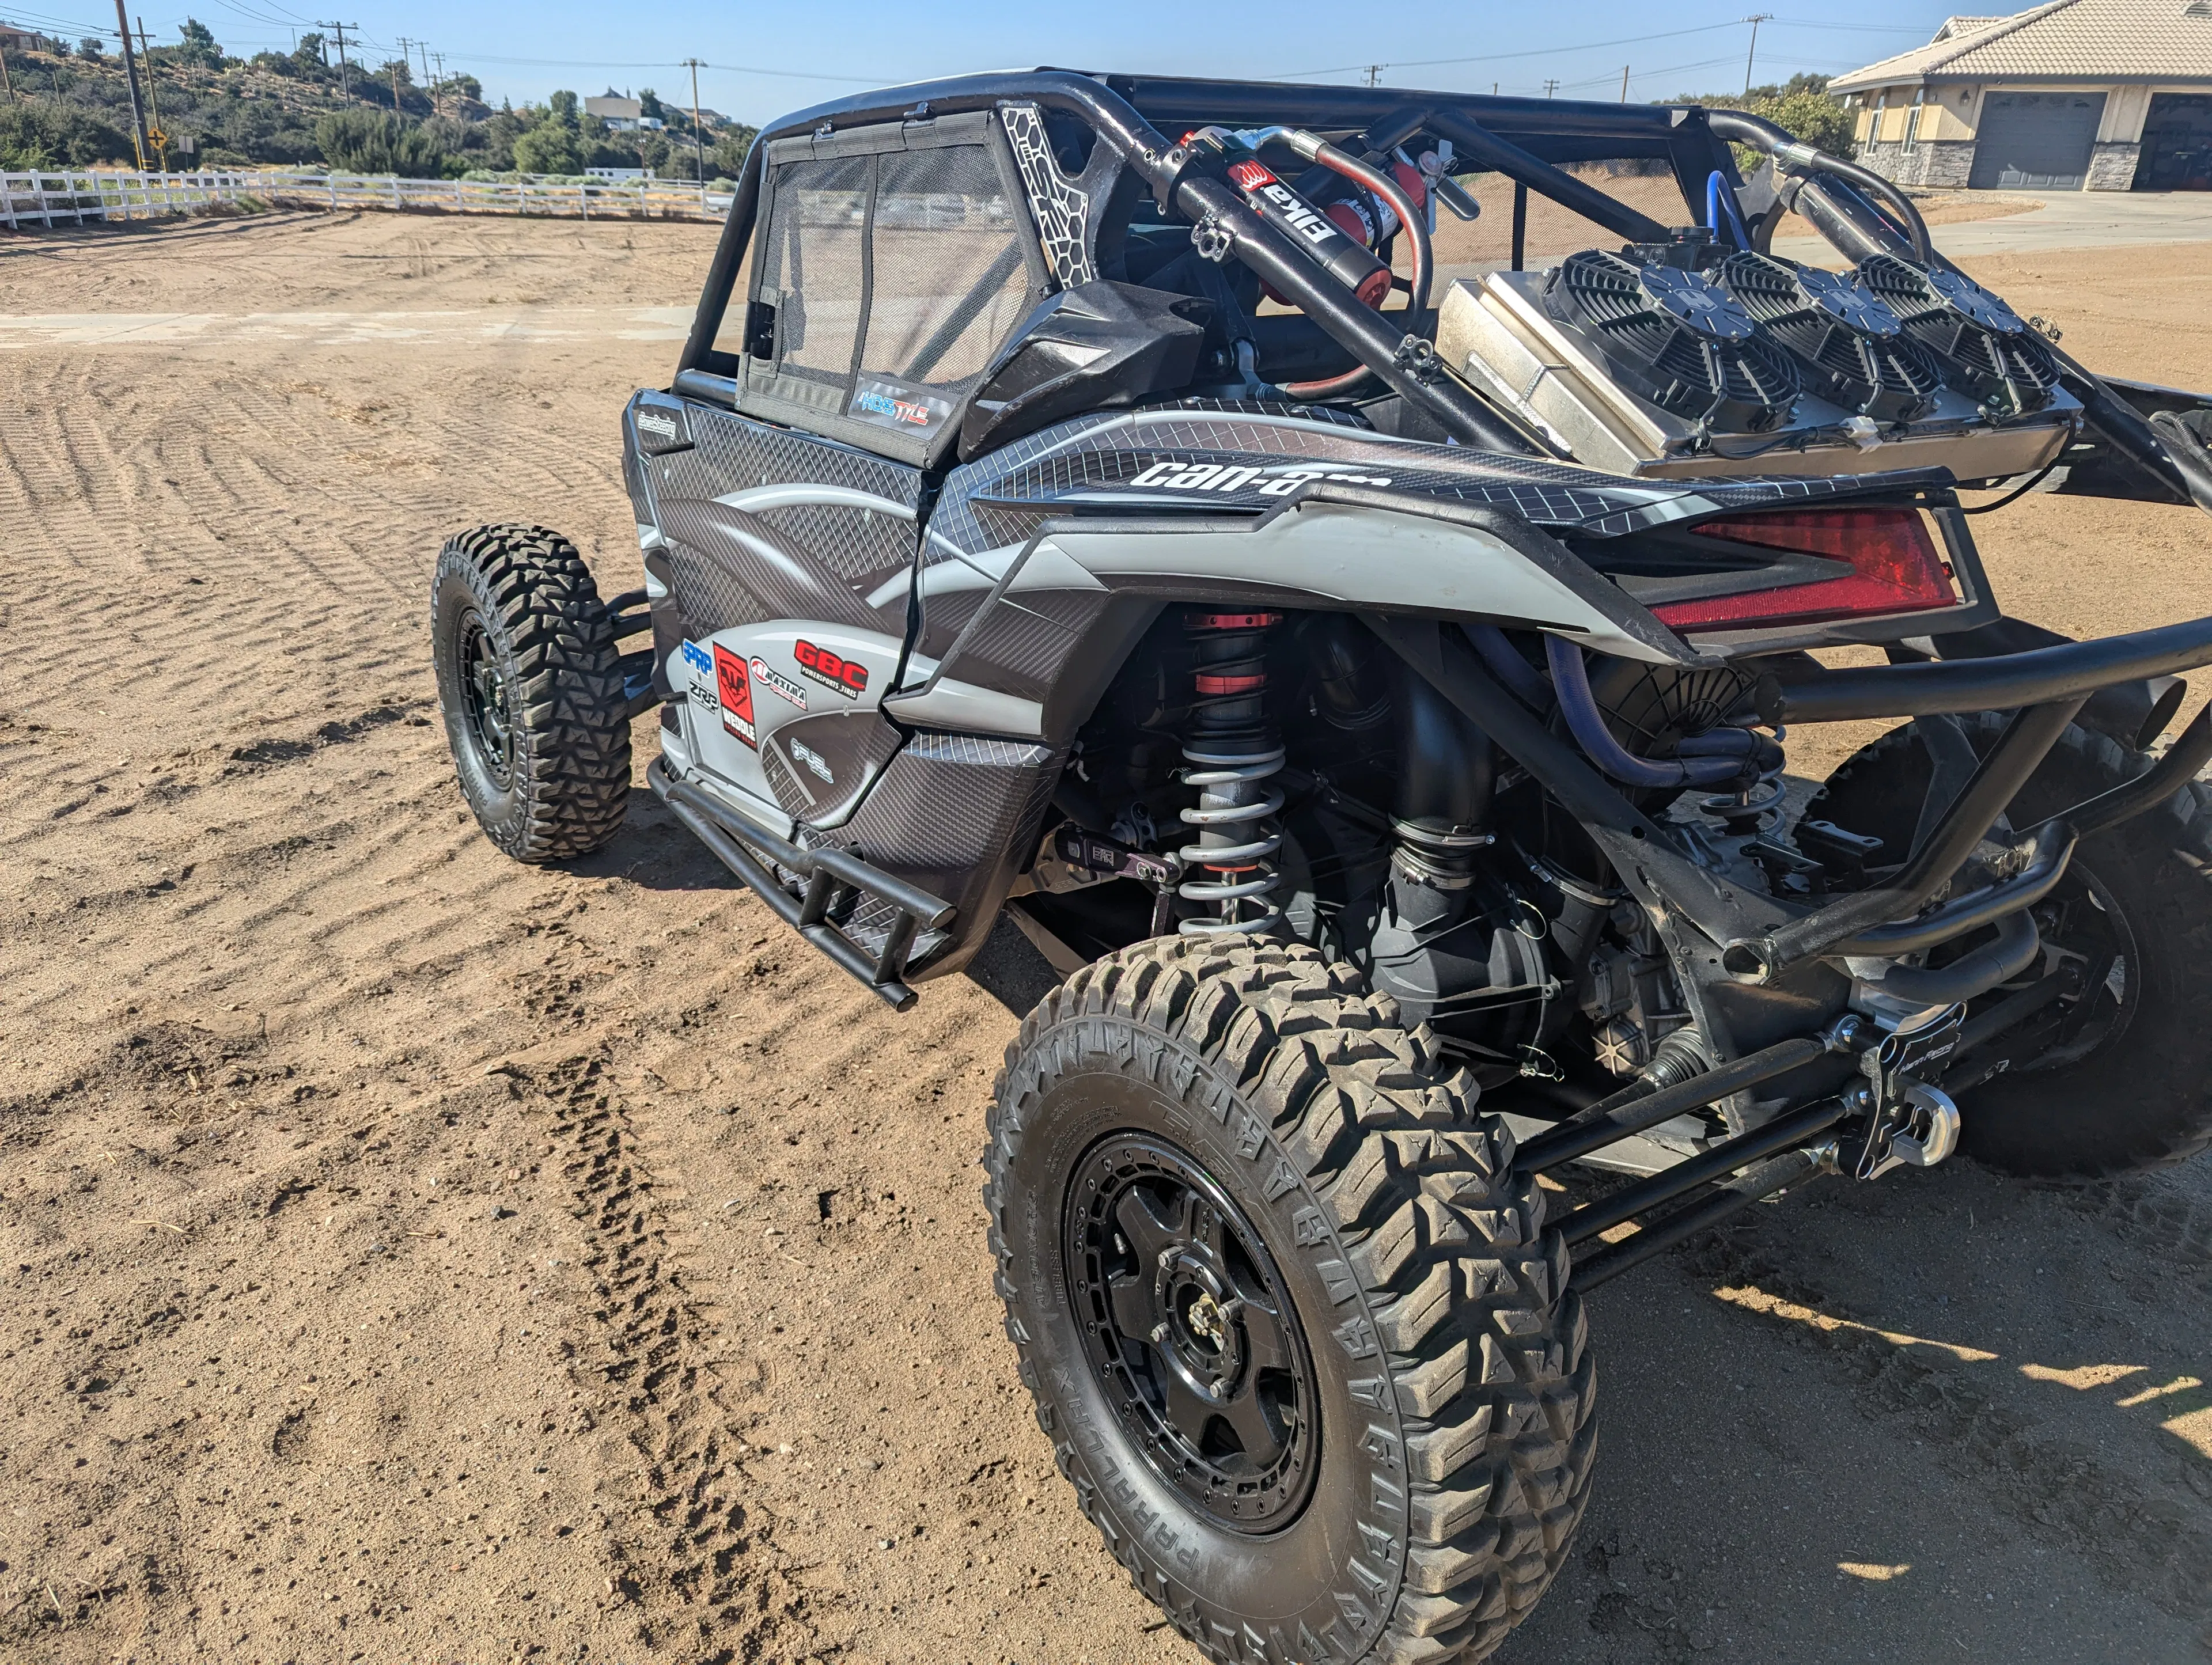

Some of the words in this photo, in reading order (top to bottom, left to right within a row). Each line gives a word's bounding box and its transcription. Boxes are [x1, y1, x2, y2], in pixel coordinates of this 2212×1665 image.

[1263, 184, 1338, 244] Elka
[795, 642, 867, 689] GBC
[801, 666, 839, 689] POWERSPORTS
[839, 684, 857, 699] TIRES
[689, 680, 718, 710] ZRP
[722, 706, 756, 742] WEDDLE
[1050, 1249, 1066, 1307] TUBELESS
